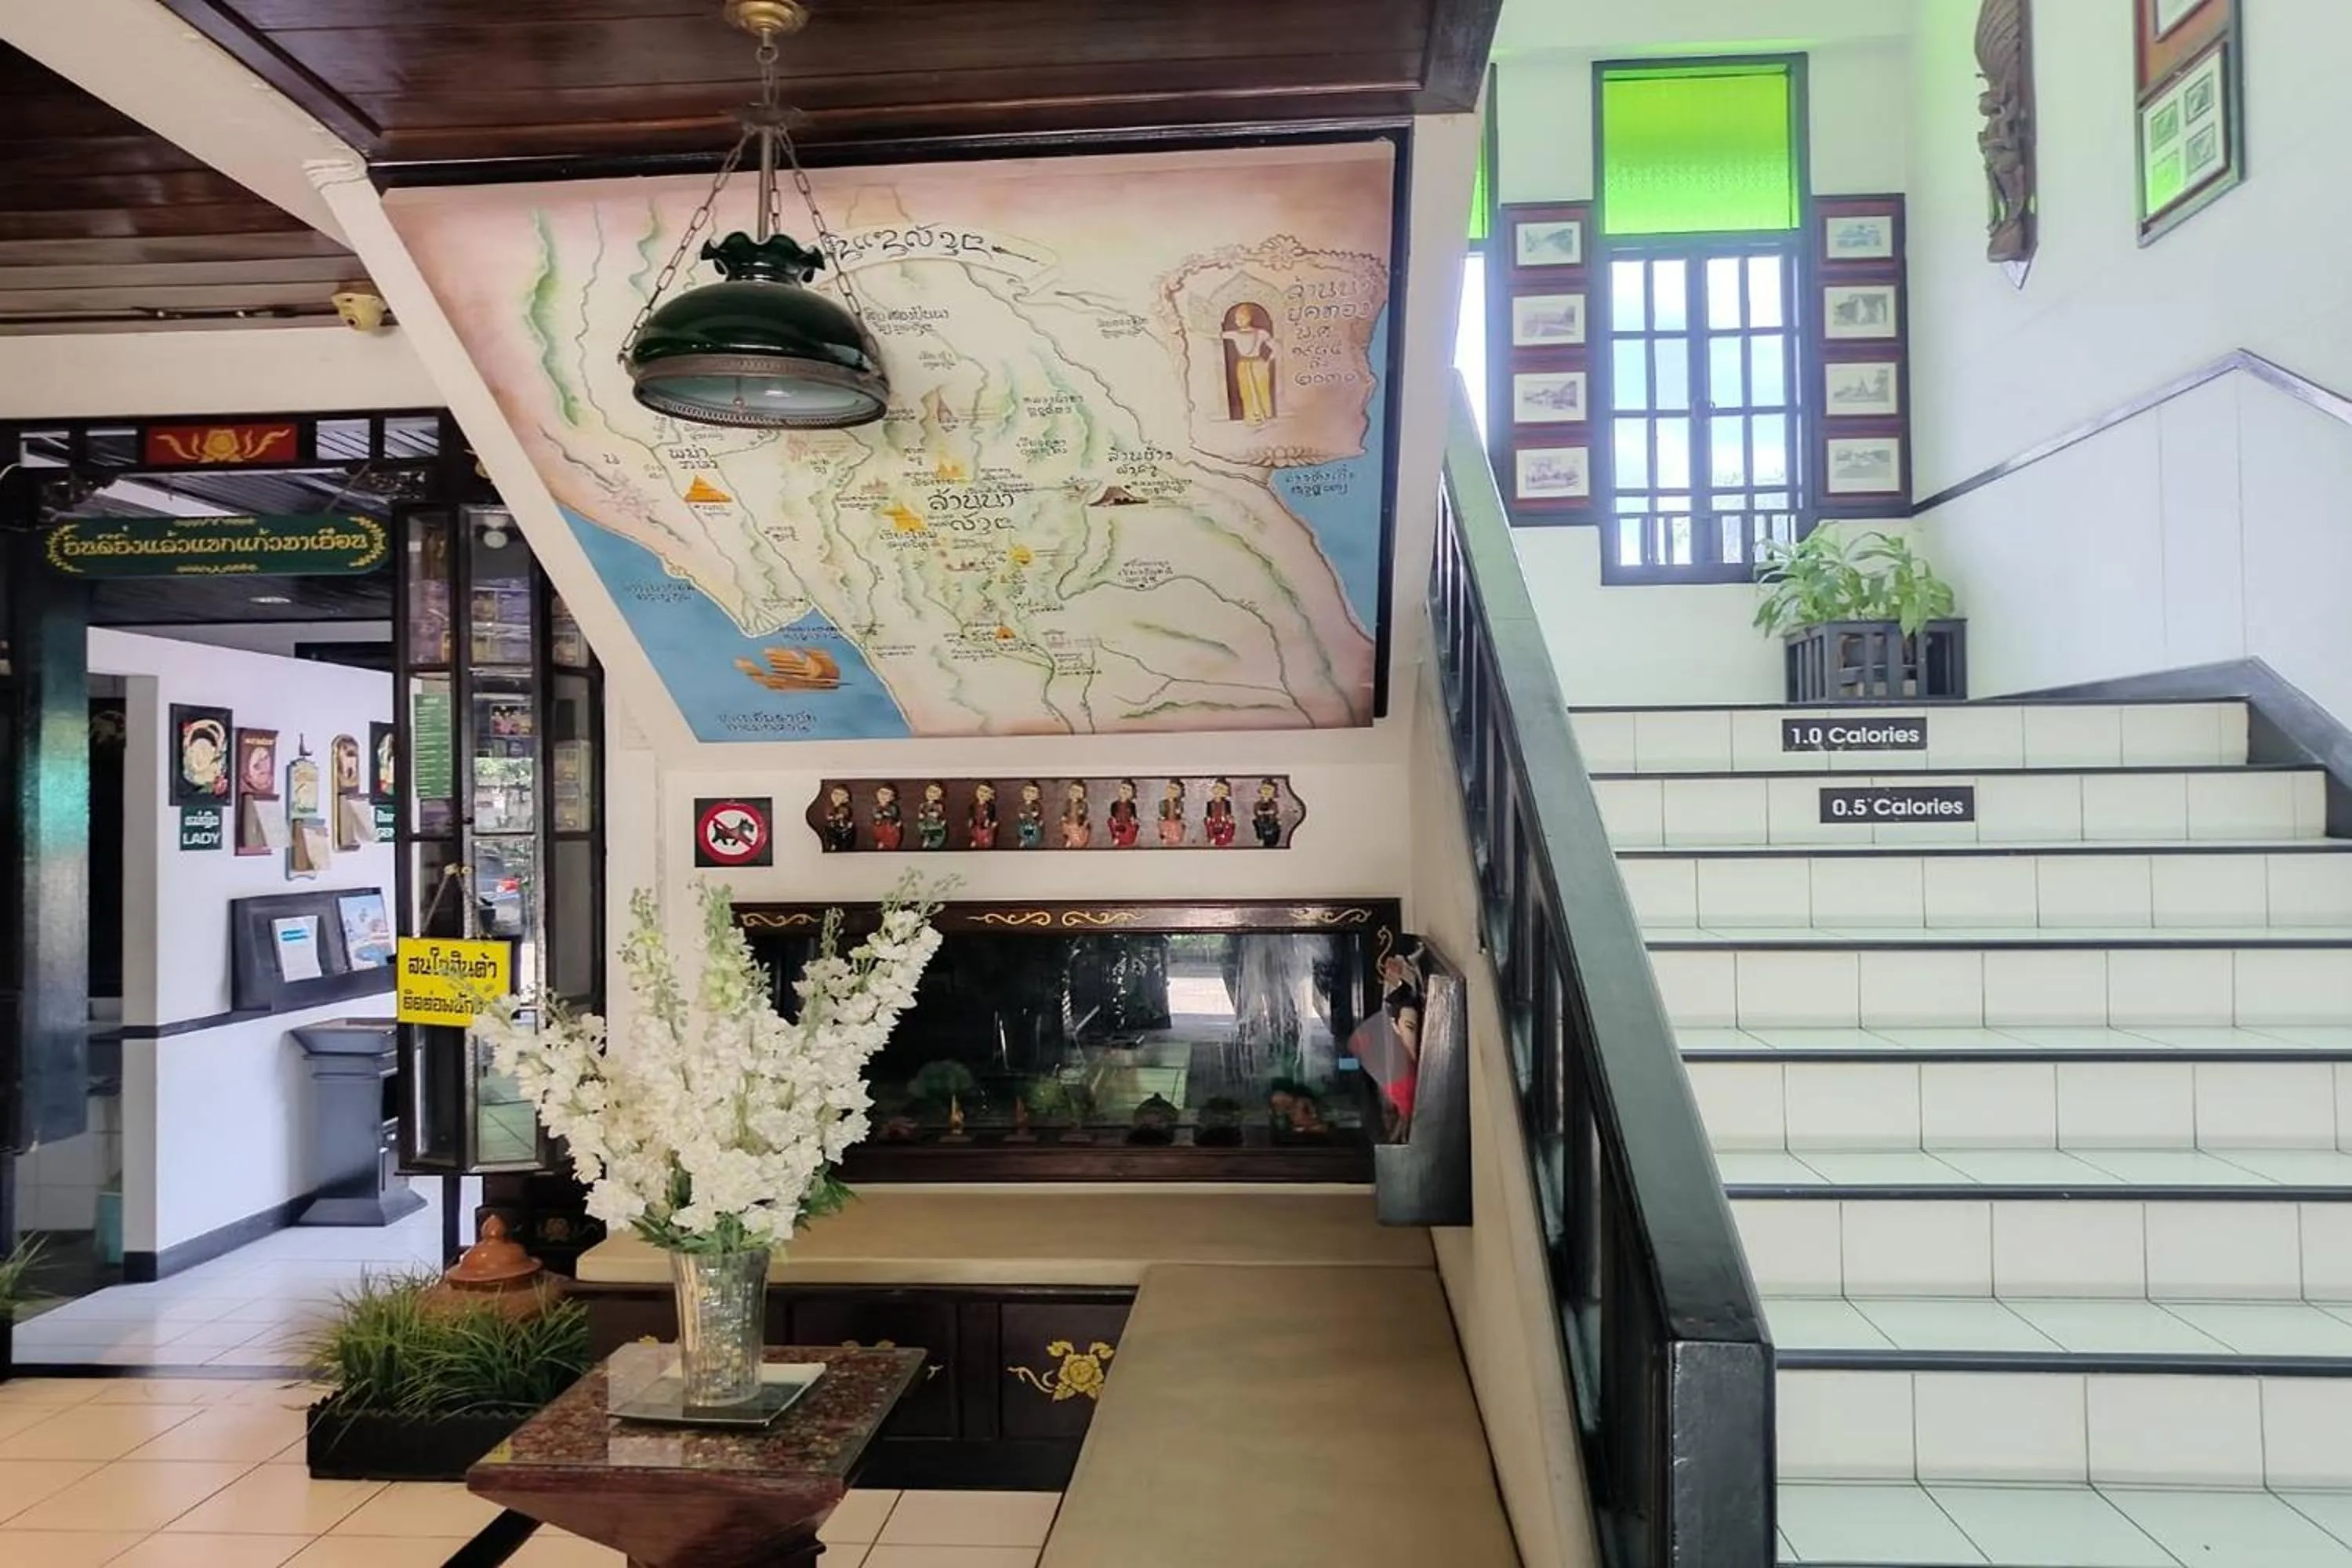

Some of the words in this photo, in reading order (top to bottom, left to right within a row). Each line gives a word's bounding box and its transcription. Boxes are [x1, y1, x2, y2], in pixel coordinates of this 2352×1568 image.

[928, 488, 1014, 511] ล้านนา
[1791, 728, 1822, 744] 1.0
[1828, 725, 1920, 744] Calories
[1832, 798, 1867, 816] 0.5
[1874, 797, 1963, 816] Calories
[183, 831, 220, 845] LADY
